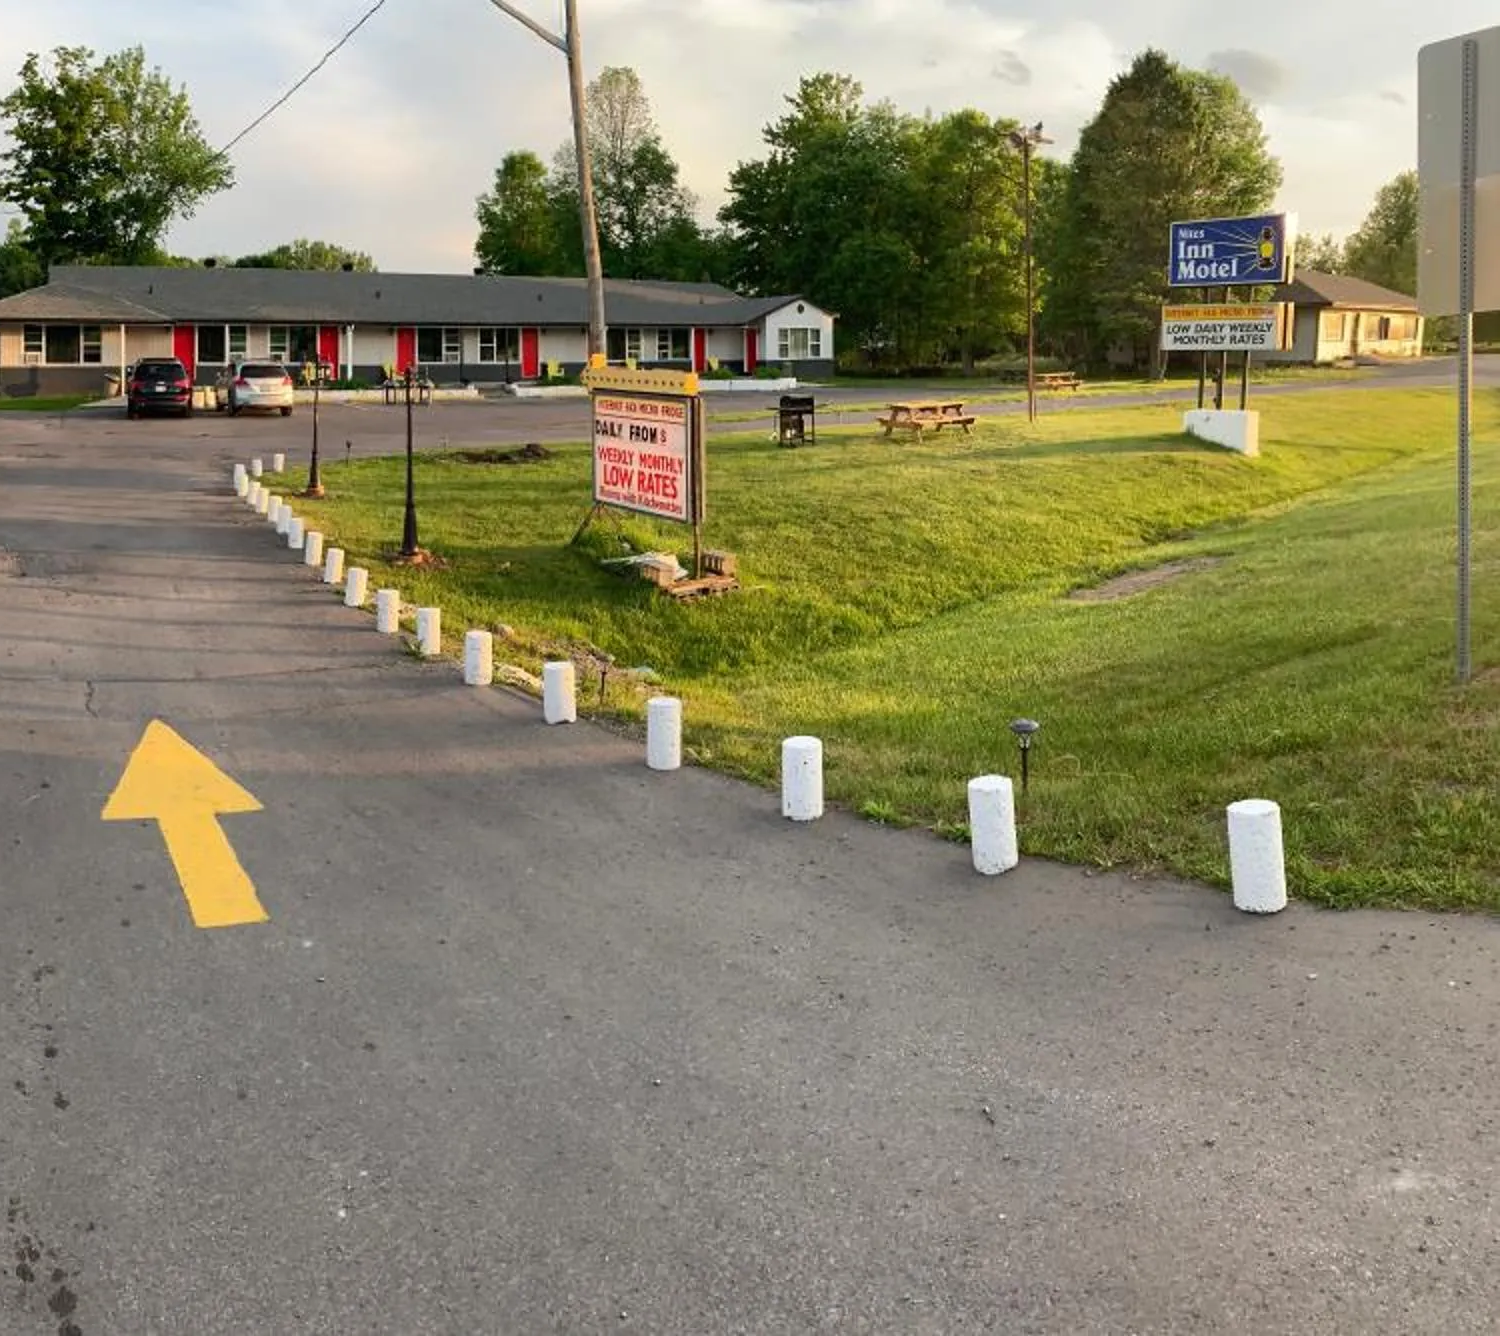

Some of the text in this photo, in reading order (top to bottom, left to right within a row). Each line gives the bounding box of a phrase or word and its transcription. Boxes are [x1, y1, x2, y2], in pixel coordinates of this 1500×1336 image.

[1178, 240, 1214, 258] Inn
[1177, 258, 1237, 279] Motel
[1167, 324, 1191, 334] LOW
[1229, 322, 1273, 332] WEEKLY
[1173, 334, 1265, 345] MONTHLY RATES
[595, 419, 622, 438] DAILY
[629, 425, 657, 444] FROM
[598, 446, 683, 474] WEEKLY MONTHLY
[603, 464, 677, 499] LOW RATES
